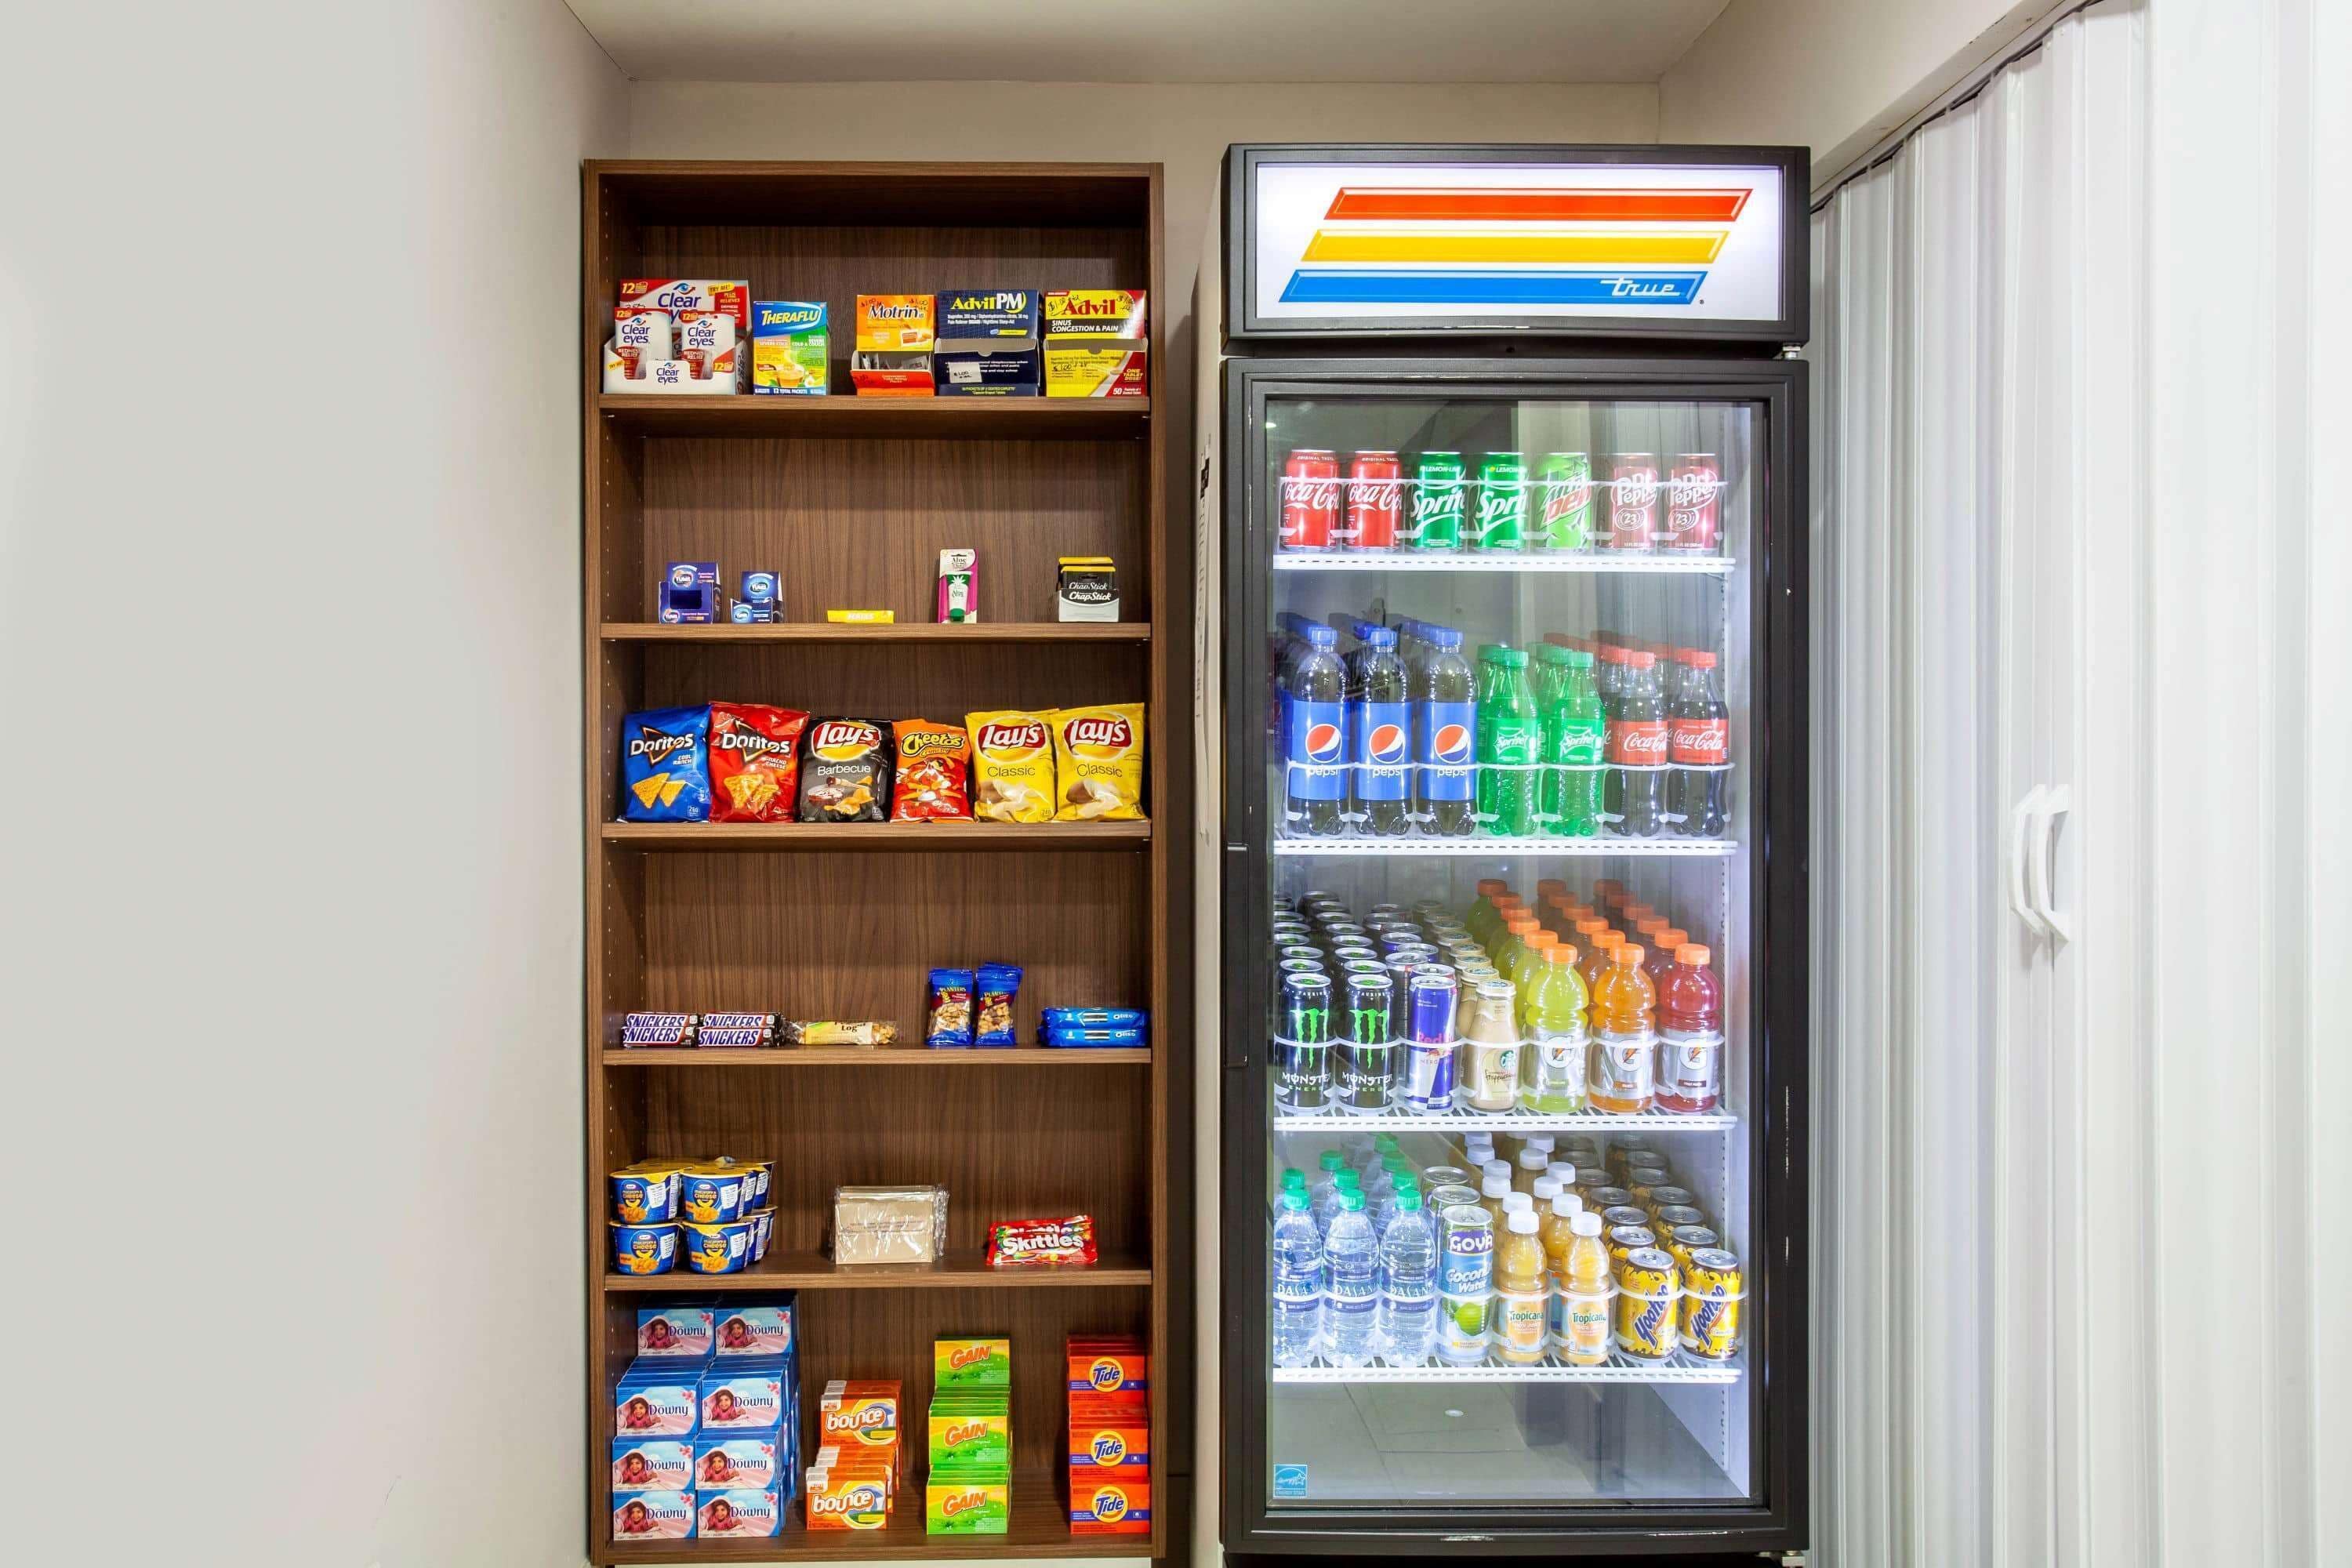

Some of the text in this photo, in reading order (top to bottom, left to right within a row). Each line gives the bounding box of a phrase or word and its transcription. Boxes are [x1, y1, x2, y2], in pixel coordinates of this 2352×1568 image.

[622, 282, 636, 294] 12
[1600, 277, 1681, 296] true
[658, 292, 702, 308] Clear
[950, 292, 1022, 310] Advil PM
[1060, 299, 1116, 315] Advil
[761, 310, 818, 326] THERAFLU
[869, 304, 919, 319] Motrin
[622, 325, 651, 335] Clear
[688, 328, 717, 337] Clear
[623, 336, 649, 345] eyes
[689, 338, 715, 348] eyes
[713, 362, 724, 372] 12
[658, 376, 679, 385] eyes
[1410, 488, 1465, 521] Sprit
[1624, 514, 1637, 524] 23
[1675, 514, 1688, 525] 23
[1069, 591, 1112, 601] ChapStick
[981, 724, 1042, 750] Lay's
[1069, 720, 1126, 746] Lay's
[1566, 734, 1595, 746] Sprite
[630, 733, 694, 756] Doritos
[722, 733, 790, 753] Doritos
[902, 733, 963, 756] Cheetos
[1498, 735, 1525, 747] Sprite
[817, 764, 871, 776] Barbecue
[987, 764, 1036, 778] Classic
[1076, 763, 1123, 778] Classic
[627, 1014, 685, 1027] SNICKERS
[705, 1015, 763, 1027] SNICKERS
[623, 1027, 681, 1042] SNICKERS
[699, 1030, 759, 1045] SNICKERS
[1003, 1233, 1084, 1254] Skittles
[1450, 1234, 1493, 1252] GOYA
[669, 1324, 706, 1338] Downy
[746, 1323, 783, 1336] Downy
[1092, 1365, 1120, 1385] Tide
[734, 1395, 773, 1409] Downy
[648, 1403, 688, 1417] Downy
[826, 1409, 885, 1432] bounce
[1094, 1439, 1123, 1459] Tide
[644, 1459, 685, 1472] Downy
[727, 1457, 768, 1470] Downy
[811, 1490, 873, 1515] bounce
[1095, 1494, 1124, 1516] Tide
[646, 1508, 687, 1520] Downy
[730, 1506, 771, 1519] Downy
